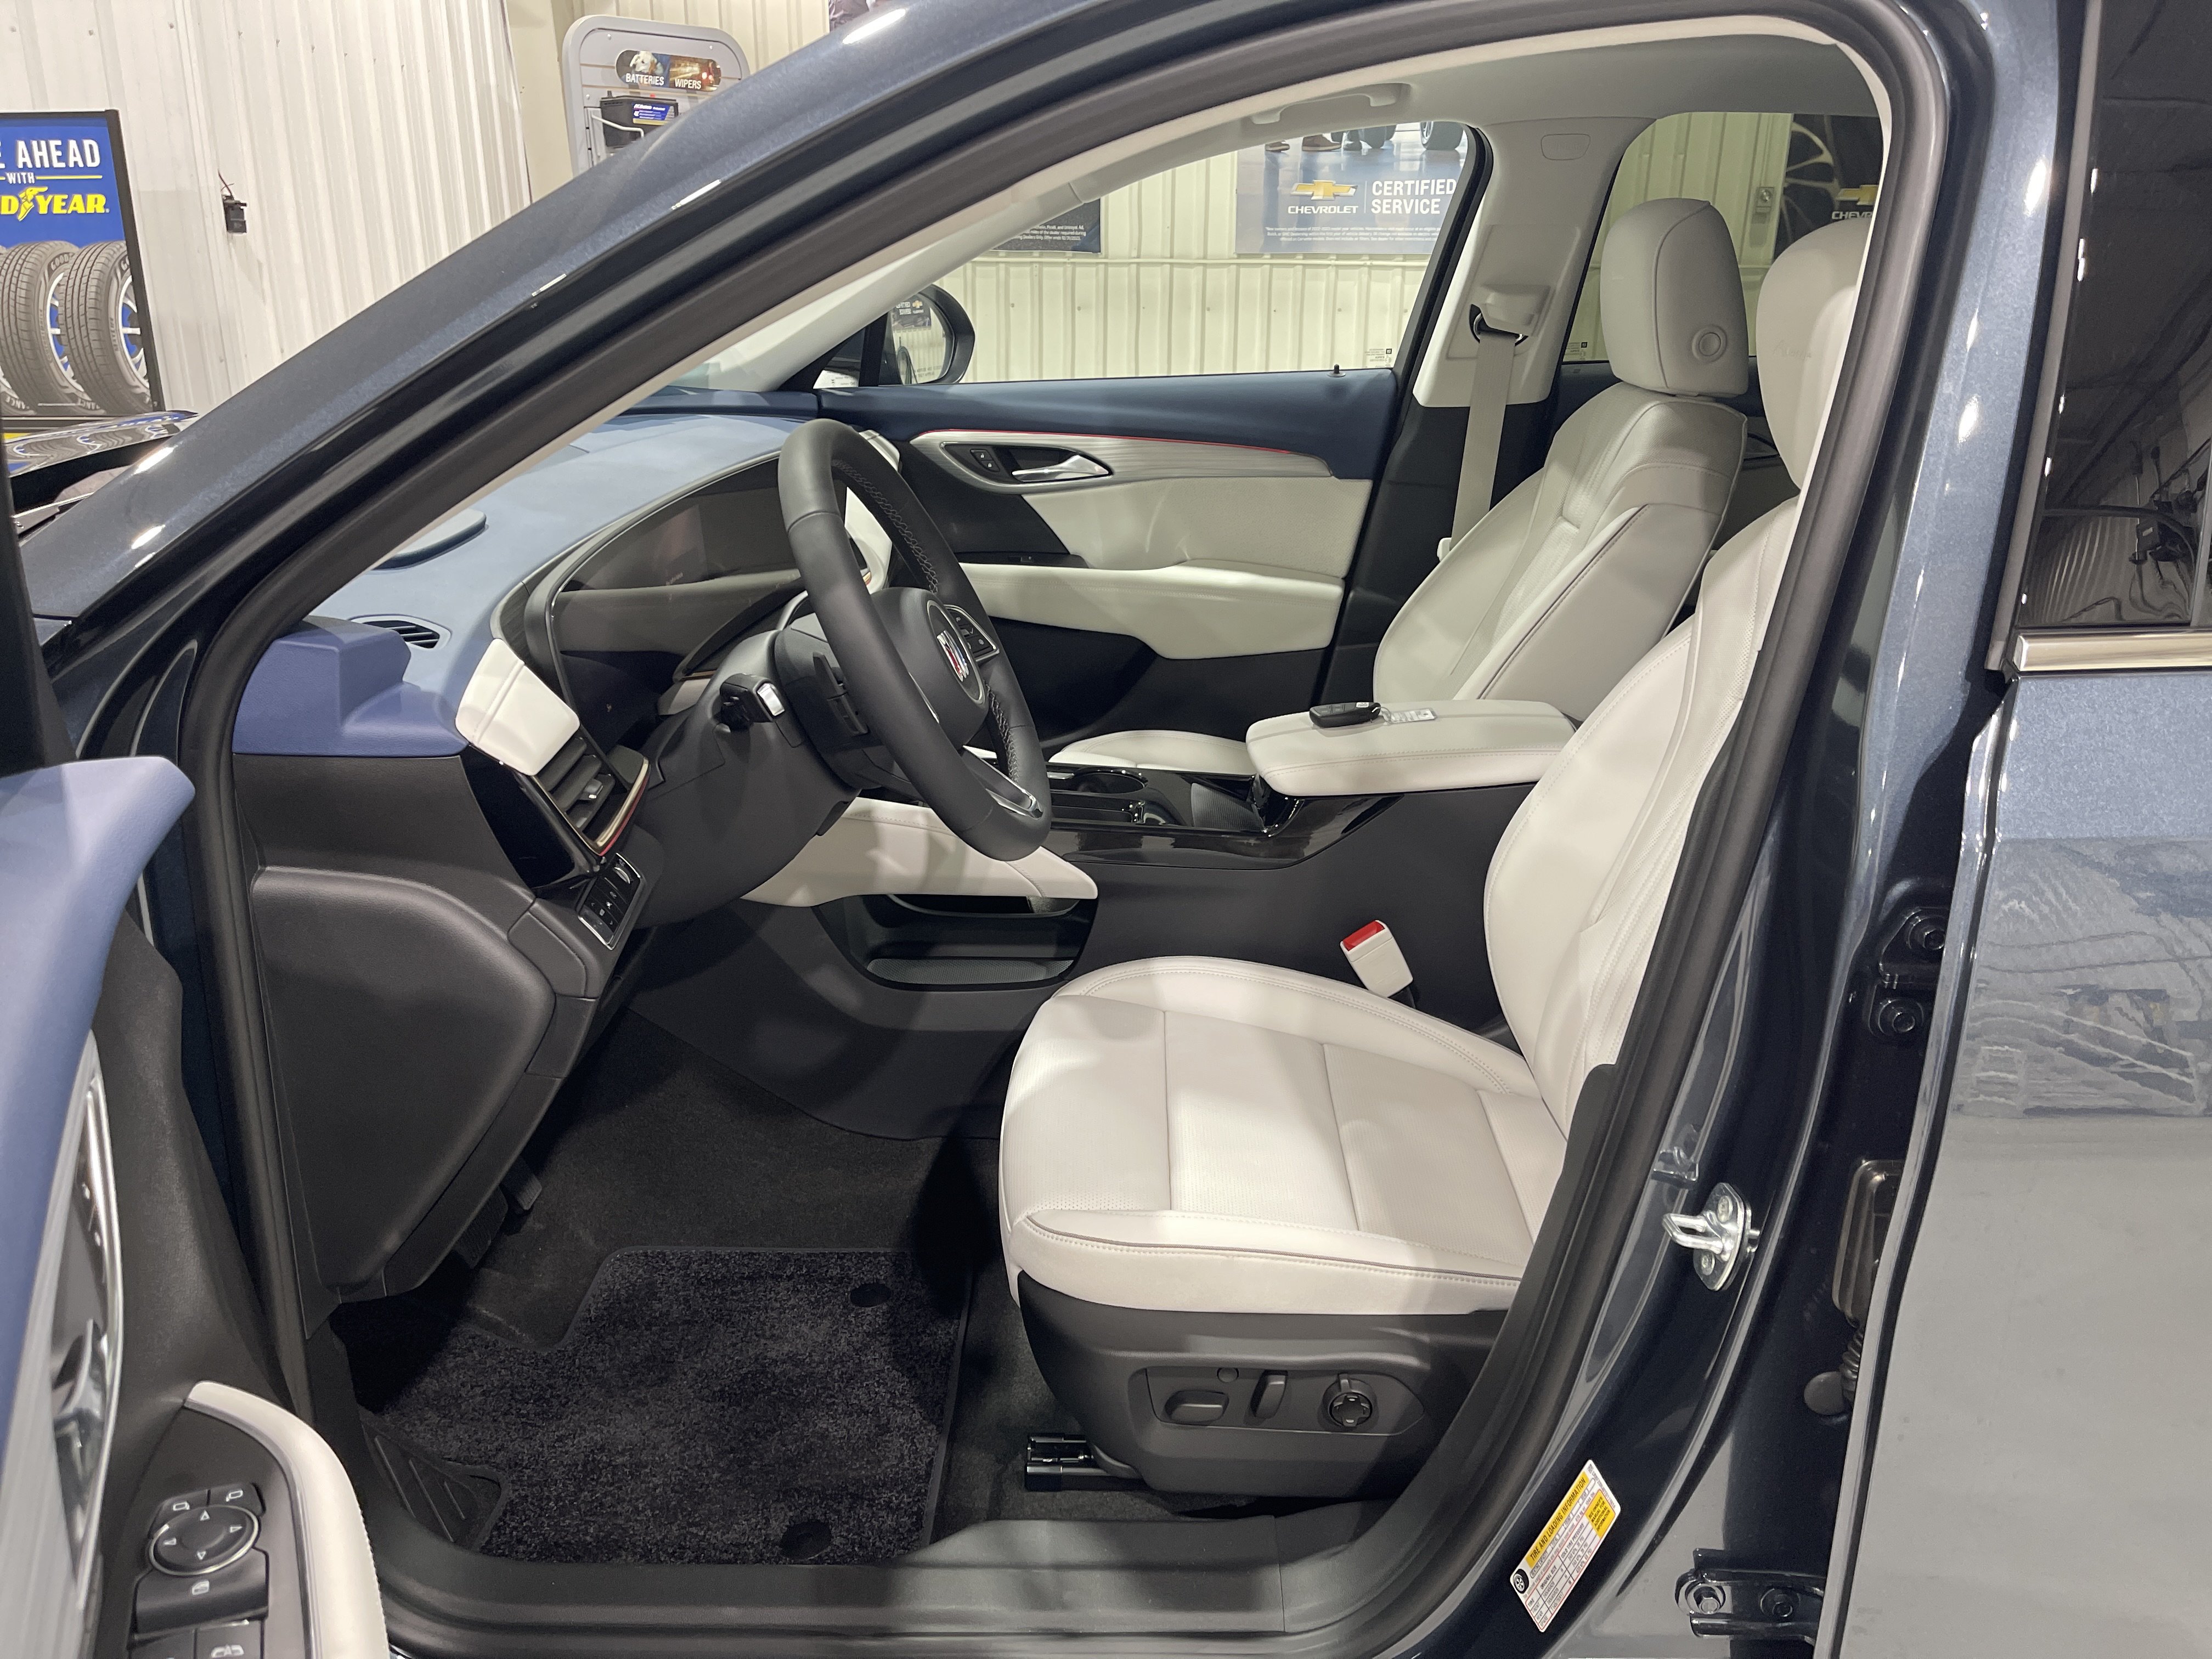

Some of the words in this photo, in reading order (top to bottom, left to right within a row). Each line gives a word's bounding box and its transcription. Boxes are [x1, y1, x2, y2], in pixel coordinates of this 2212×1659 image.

[625, 73, 664, 86] BATTERIES
[675, 78, 702, 89] WIPERS
[17, 139, 101, 168] AHEAD
[6, 172, 35, 184] WITH
[1372, 179, 1457, 196] CERTIFIED
[1288, 205, 1359, 214] CHEVROLET
[1371, 198, 1441, 215] SERVICE
[1530, 1546, 1540, 1561] TIRE
[1538, 1534, 1548, 1550] AND
[1546, 1511, 1563, 1537] LOADING
[1560, 1477, 1586, 1515] INFORMATION
